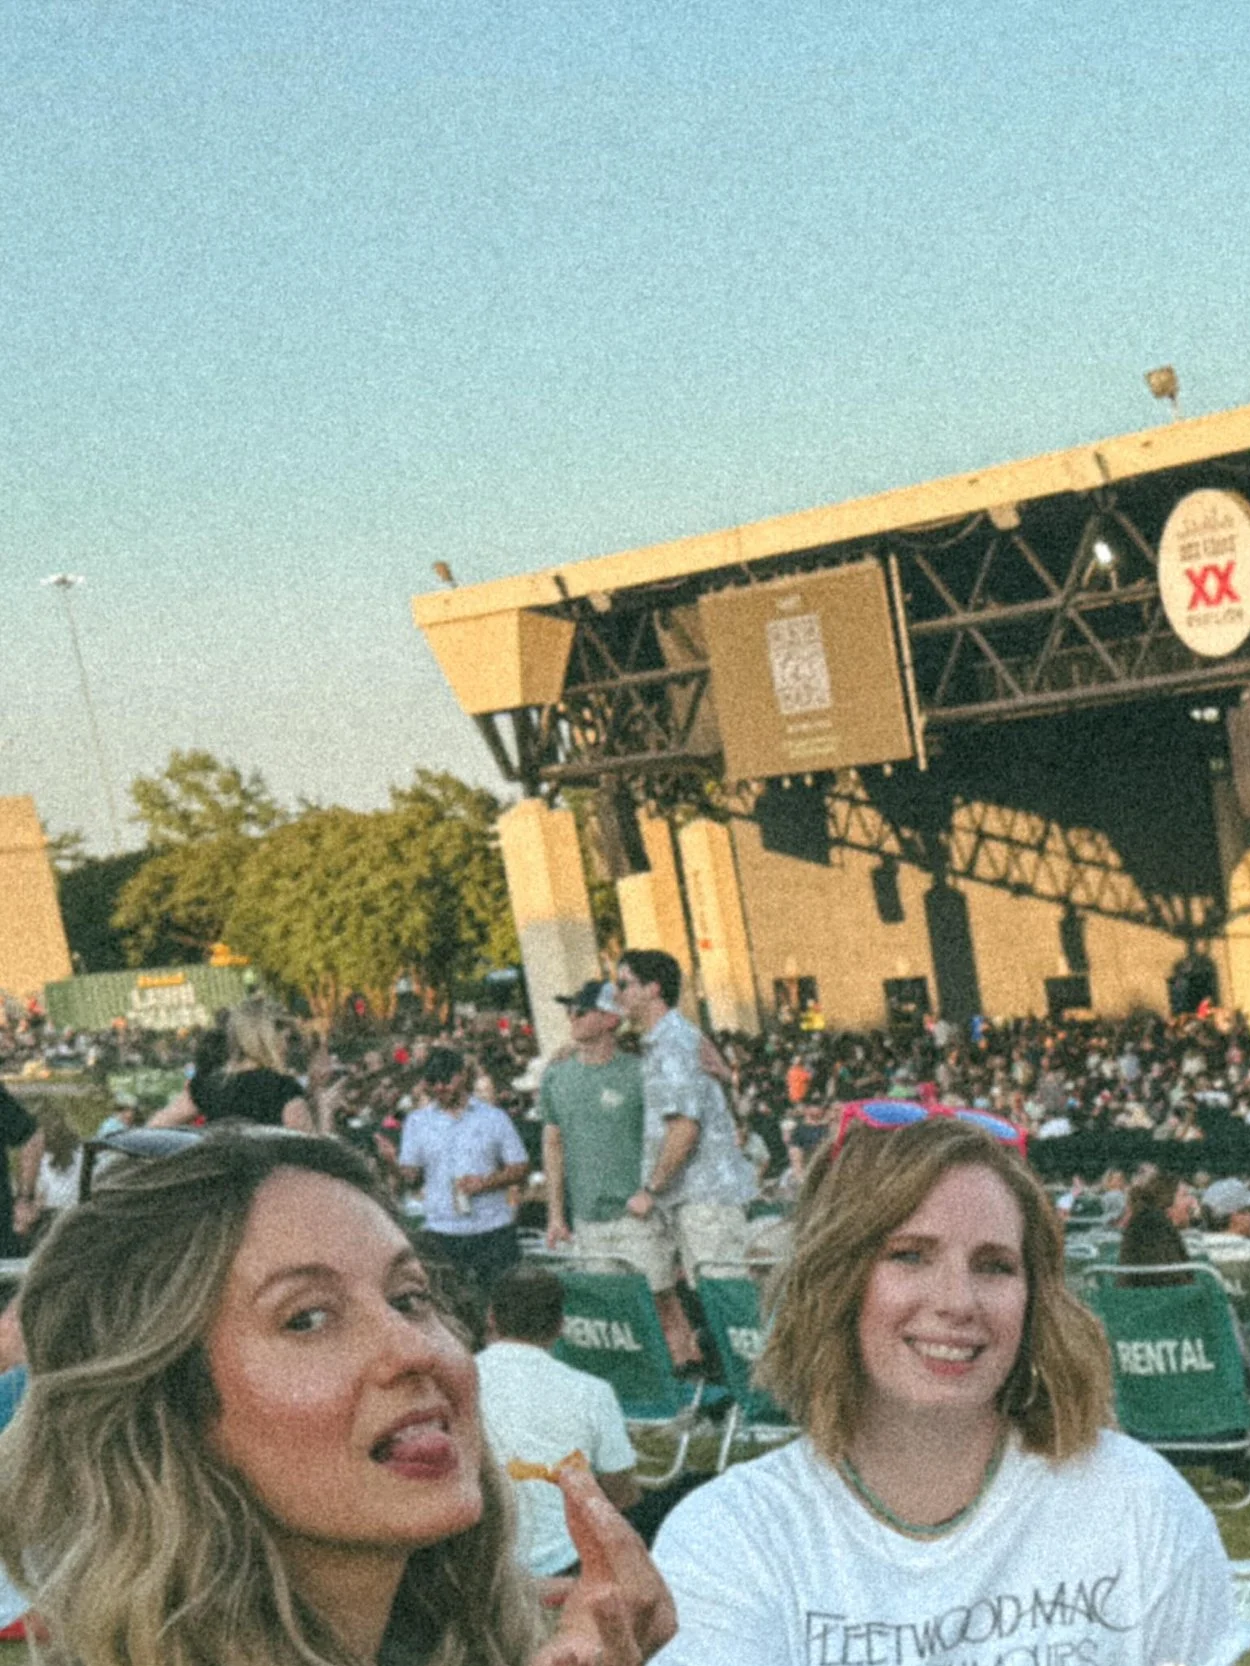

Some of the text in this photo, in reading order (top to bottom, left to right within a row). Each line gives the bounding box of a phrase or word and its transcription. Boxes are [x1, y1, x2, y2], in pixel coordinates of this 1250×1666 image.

[1184, 561, 1241, 611] XX
[1116, 1337, 1214, 1376] RENTAL
[1024, 1566, 1140, 1634] MAC
